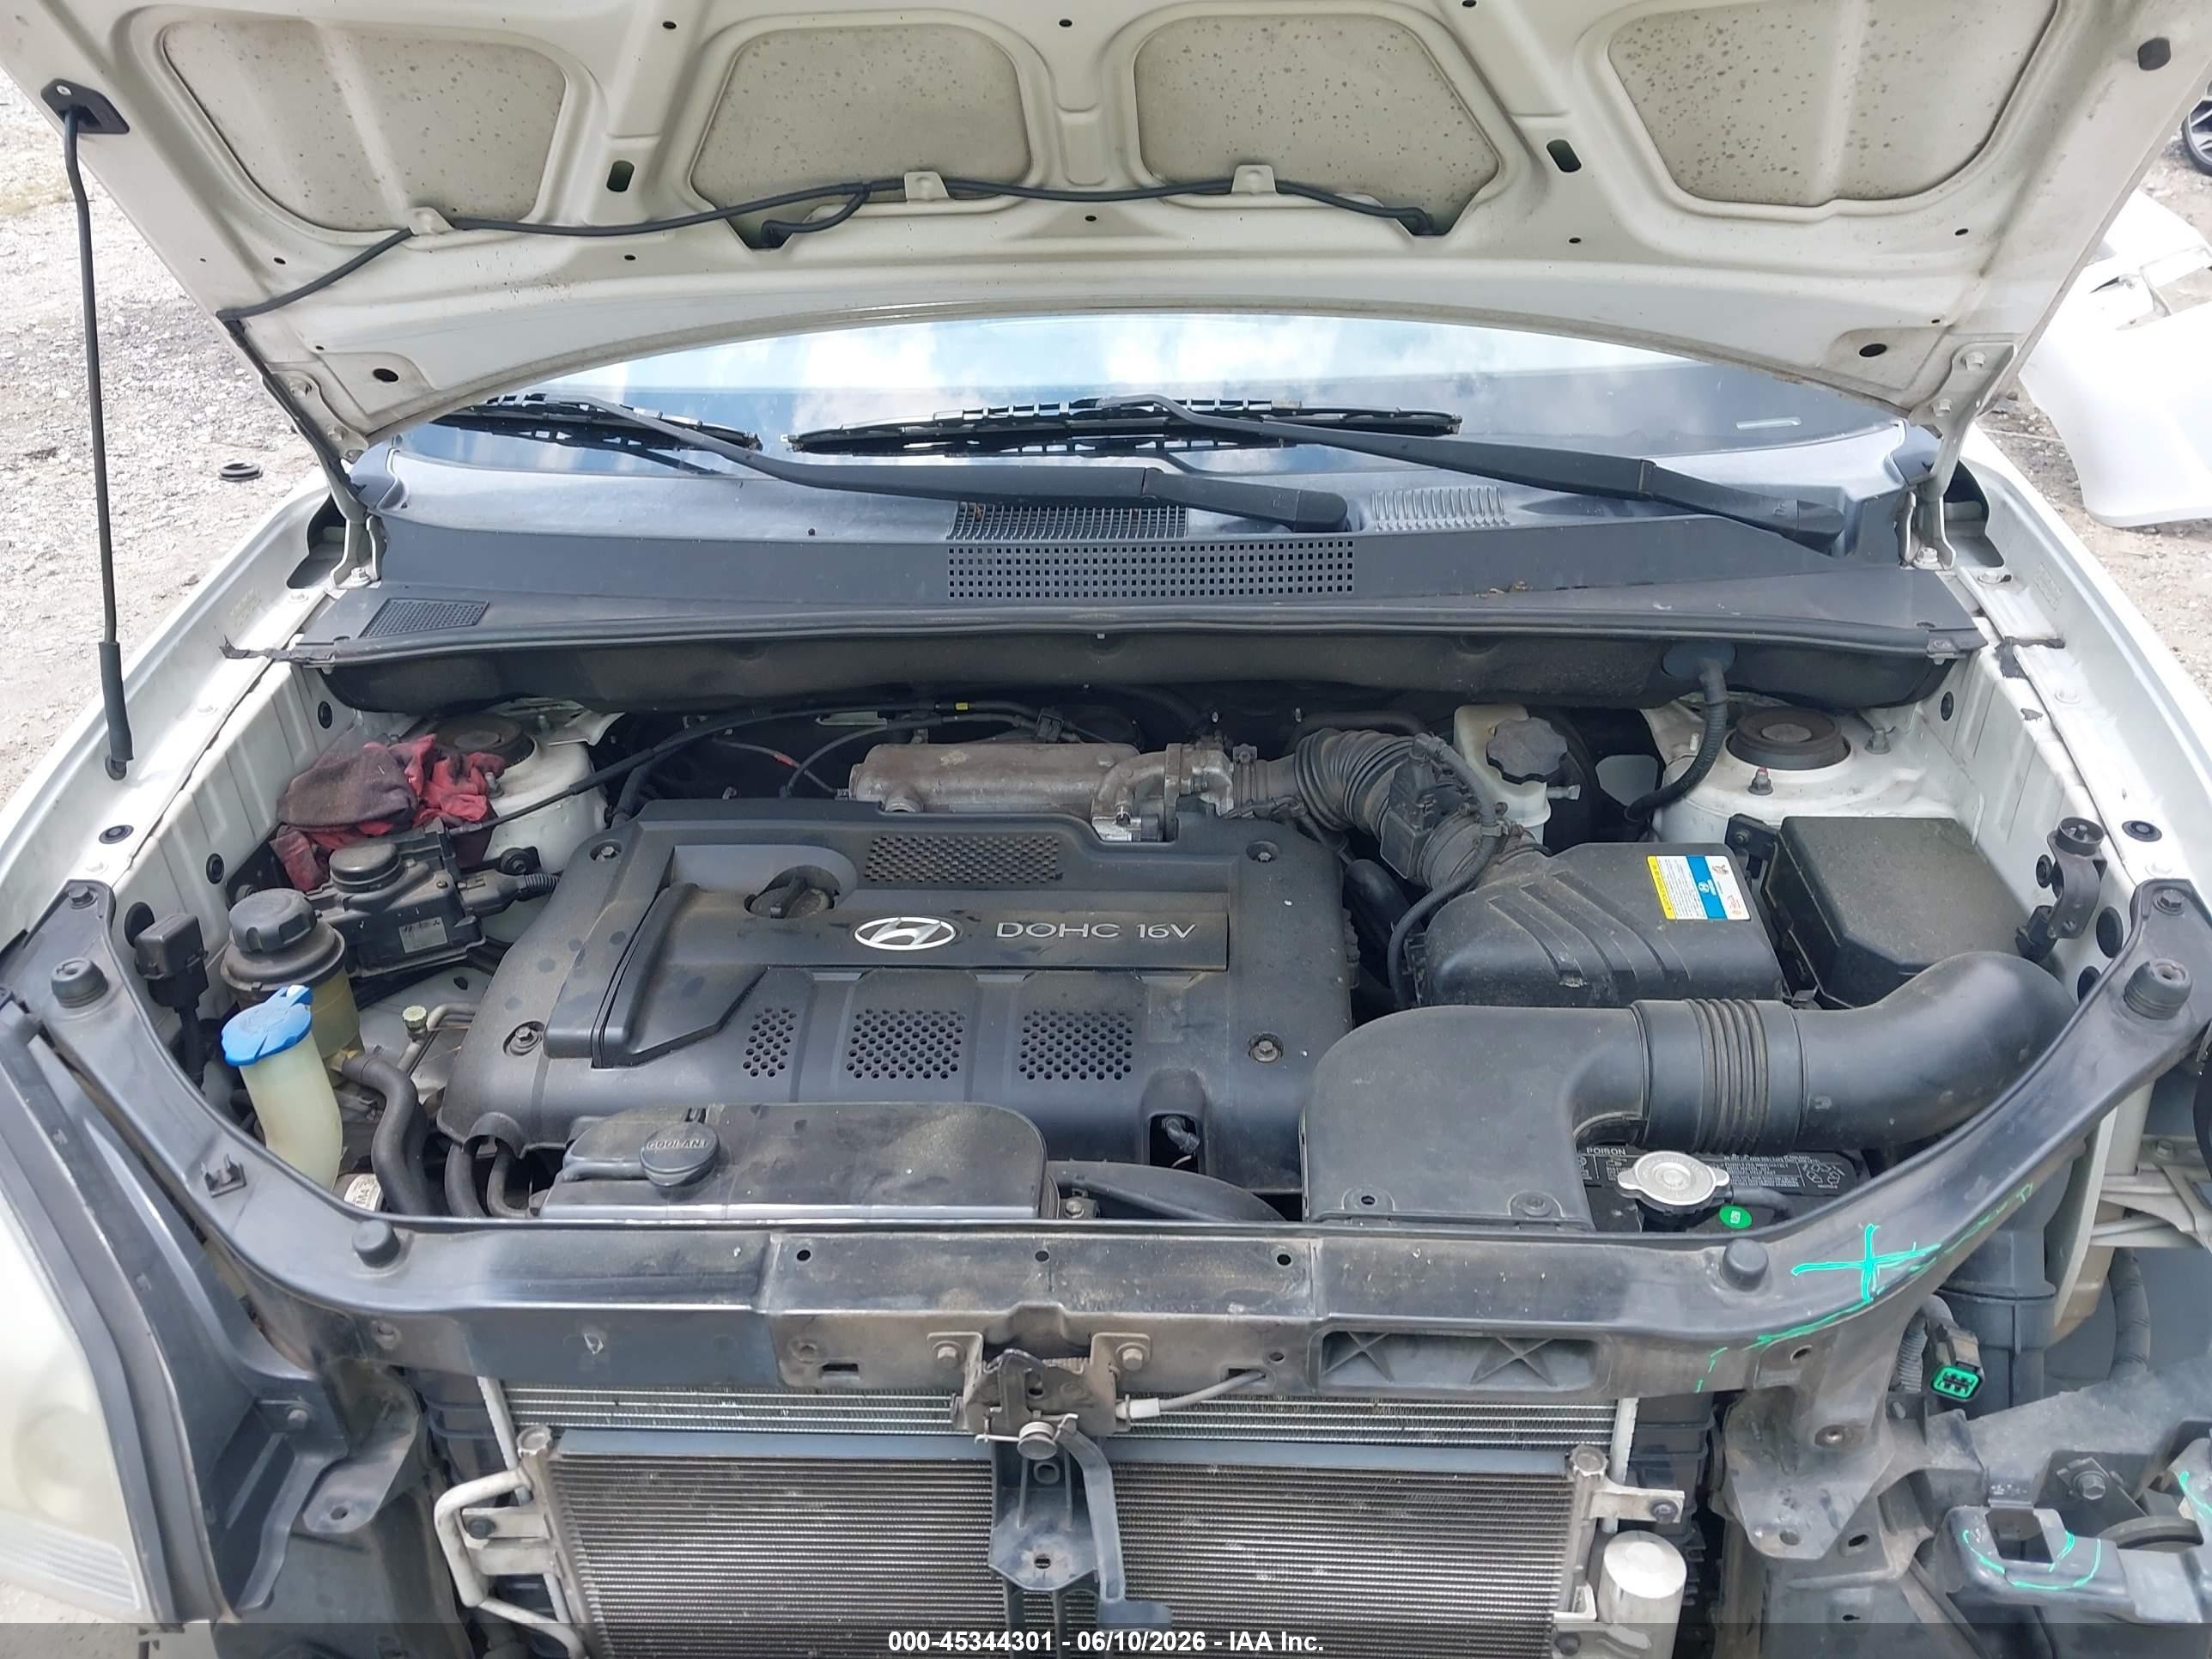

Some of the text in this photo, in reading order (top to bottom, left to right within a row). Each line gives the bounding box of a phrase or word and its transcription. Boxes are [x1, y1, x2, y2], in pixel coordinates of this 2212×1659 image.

[996, 921, 1196, 939] DOHC 16V
[646, 1139, 708, 1152] COOLANT
[1586, 1146, 1626, 1156] POISON
